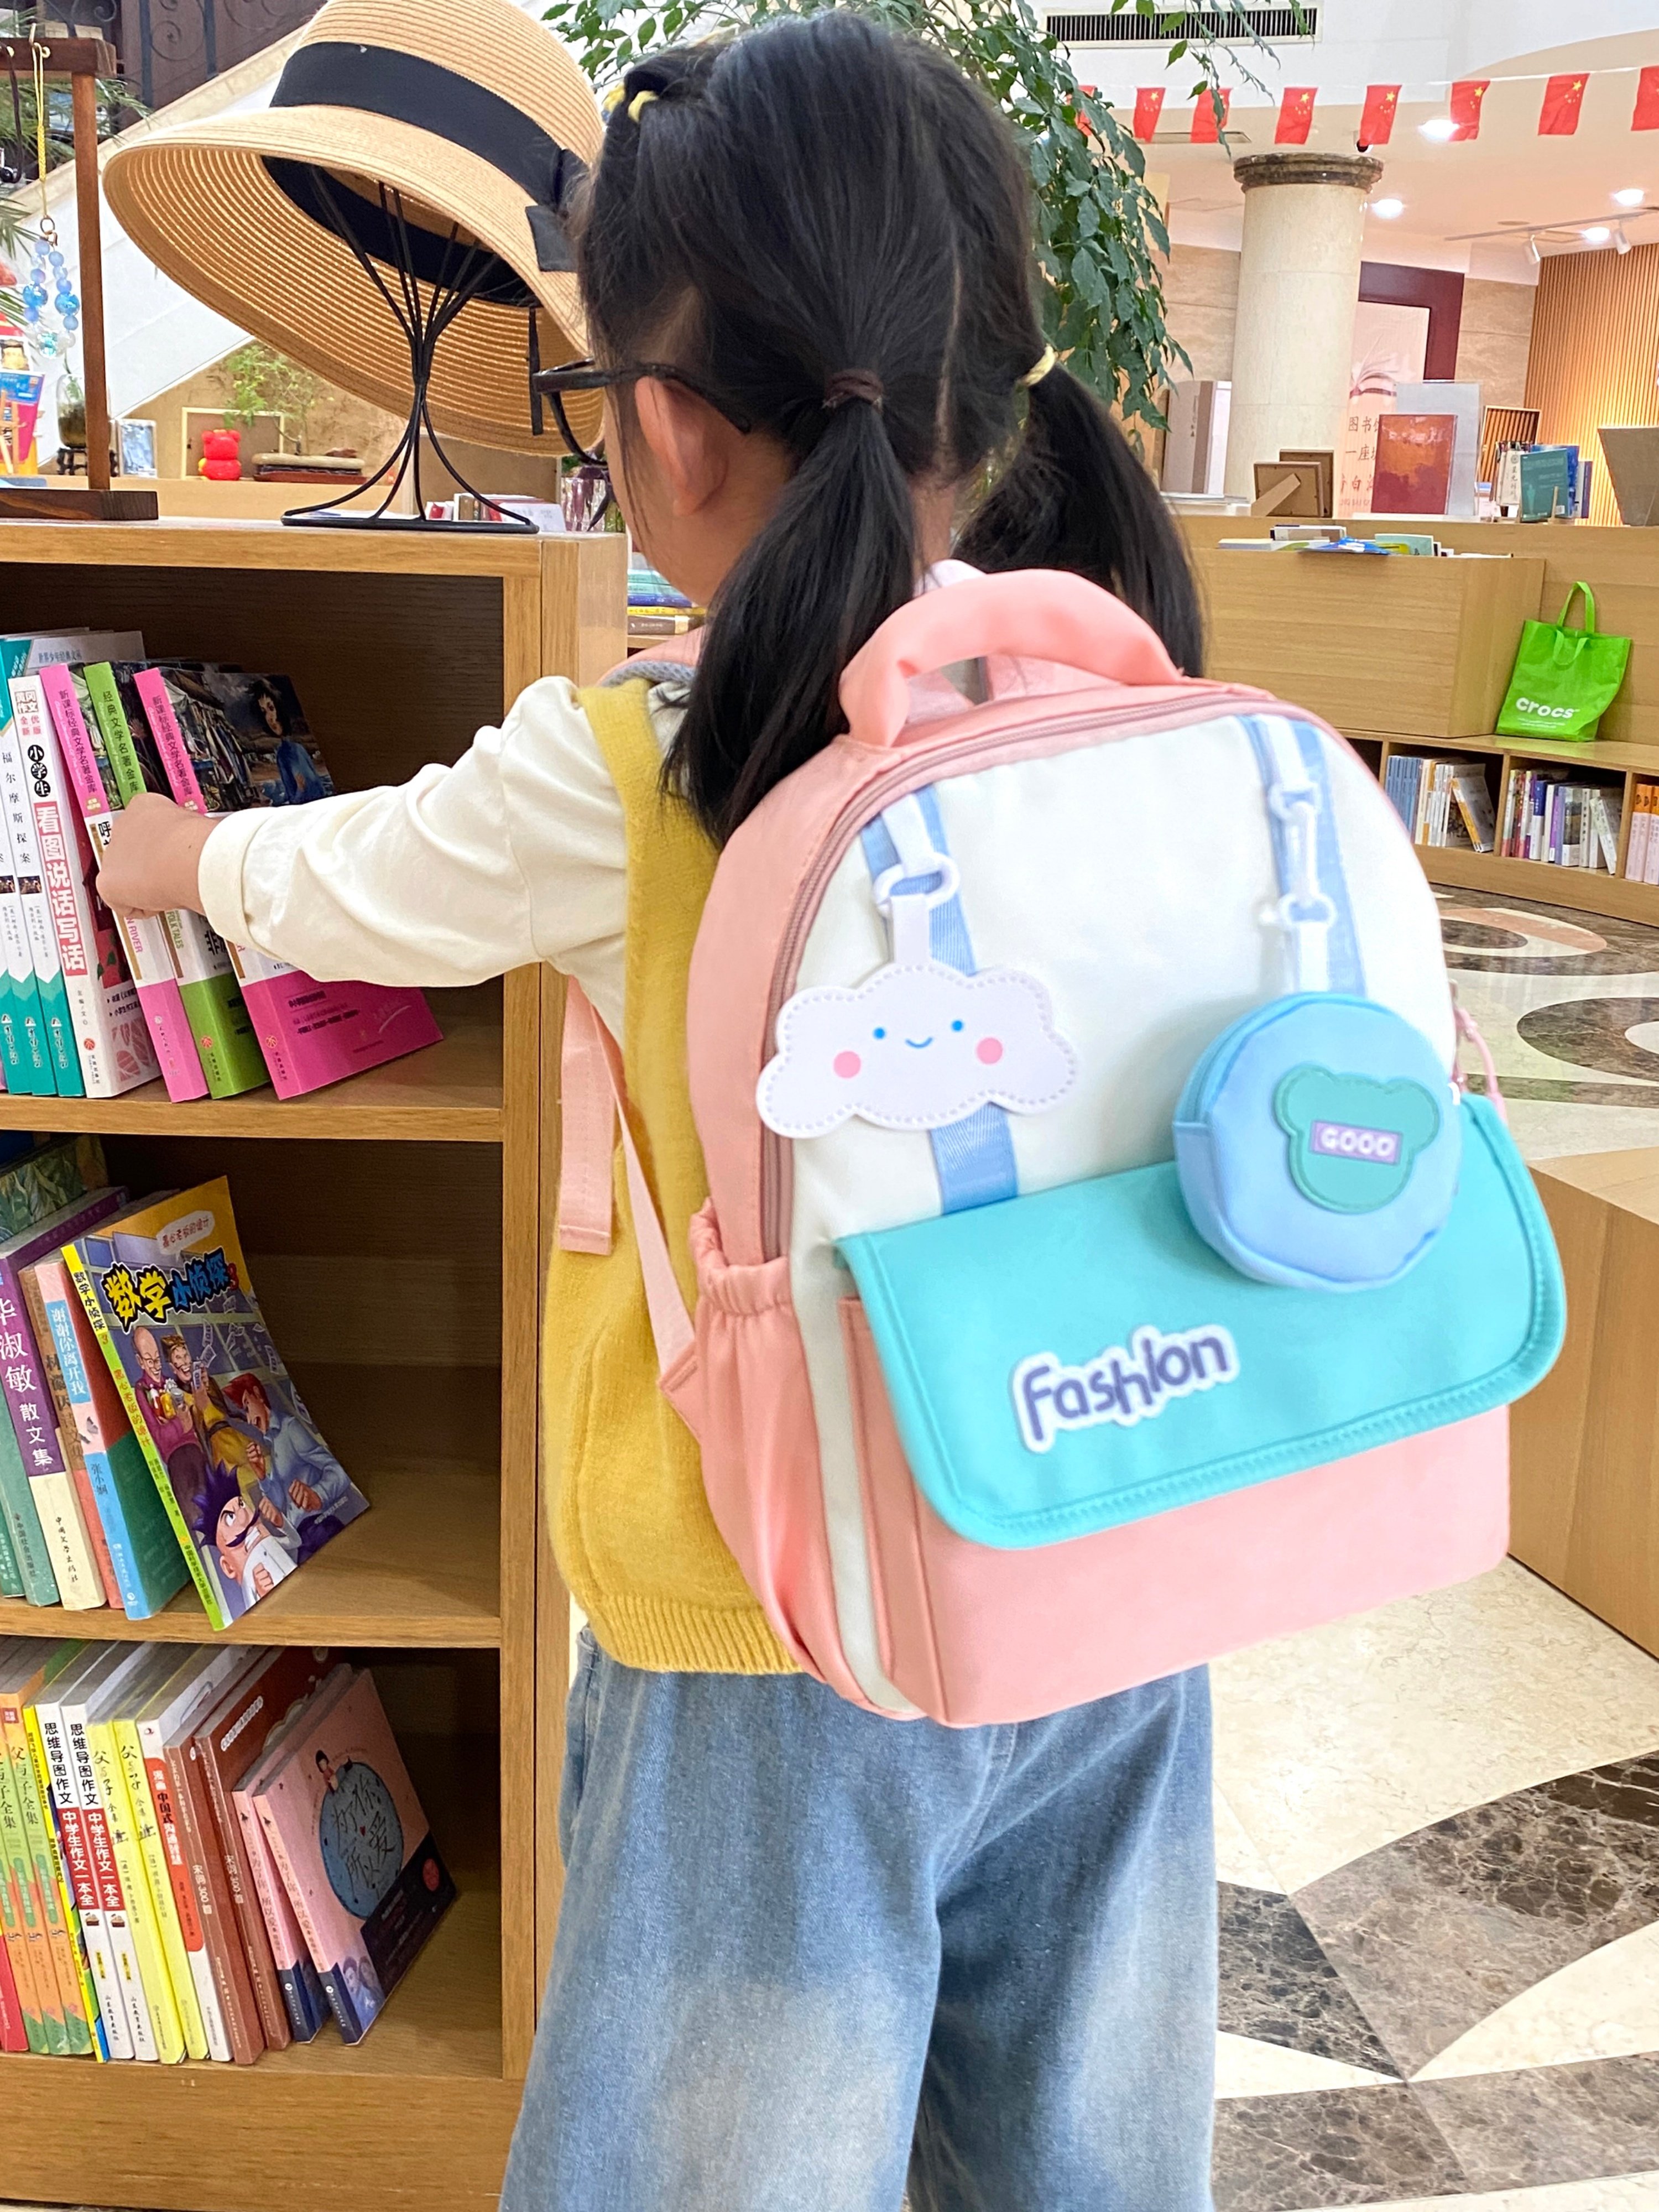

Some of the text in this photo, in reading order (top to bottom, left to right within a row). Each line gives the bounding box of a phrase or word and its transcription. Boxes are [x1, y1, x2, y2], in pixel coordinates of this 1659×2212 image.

[1516, 697, 1574, 718] crocs
[2, 752, 30, 863] 福尔摩斯探案
[28, 745, 50, 797] 小学生
[1321, 1127, 1395, 1157] GOOD
[74, 1272, 105, 1331] 数学小侦探
[51, 1307, 87, 1395] 谢谢你离开我
[11, 1746, 39, 1824] 父与子全集
[44, 1722, 73, 1804] 思维导图作文
[70, 1724, 99, 1806] 思维导图作文
[62, 1811, 95, 1906] 中学生作文一本全
[88, 1812, 121, 1907] 中学生作文一本全
